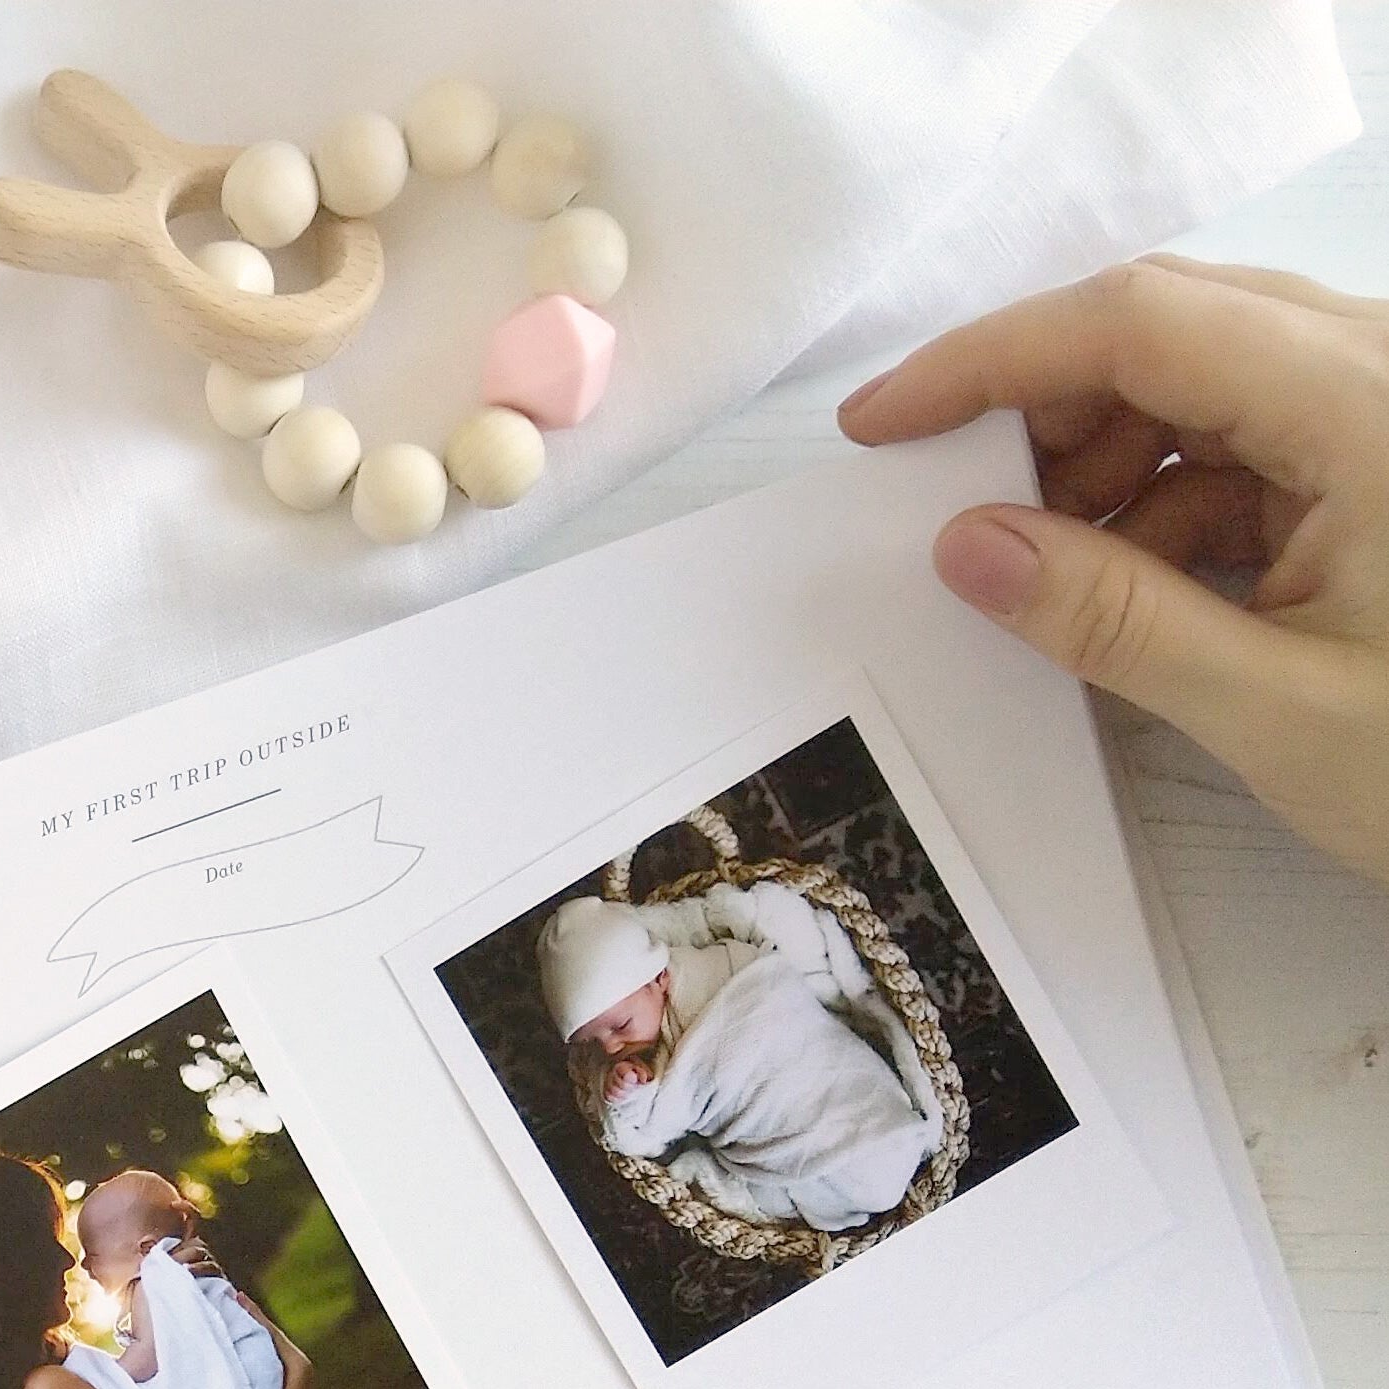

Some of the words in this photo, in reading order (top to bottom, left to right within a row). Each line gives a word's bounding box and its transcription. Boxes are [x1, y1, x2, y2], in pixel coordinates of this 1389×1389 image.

[41, 810, 75, 838] MY
[86, 781, 158, 822] FIRST
[169, 758, 228, 792] TRIP
[239, 713, 351, 767] OUTSIDE
[205, 861, 243, 884] Date
